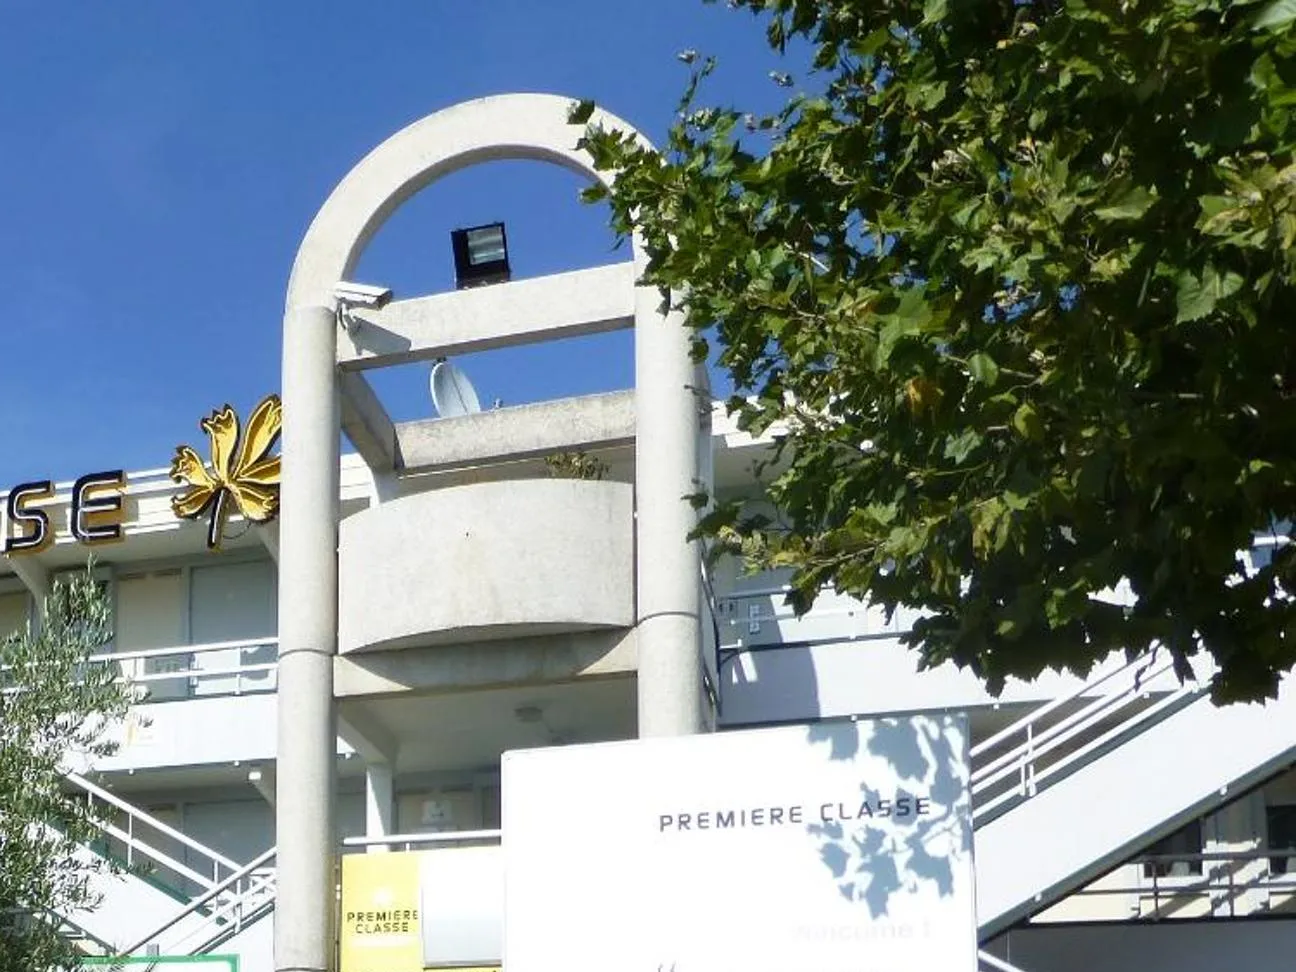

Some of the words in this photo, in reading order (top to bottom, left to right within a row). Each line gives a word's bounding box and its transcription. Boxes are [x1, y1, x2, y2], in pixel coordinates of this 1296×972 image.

[658, 806, 803, 832] PREMIERE
[819, 797, 931, 822] CLASSE
[346, 909, 418, 922] PREMIERE
[355, 921, 409, 934] CLASSE
